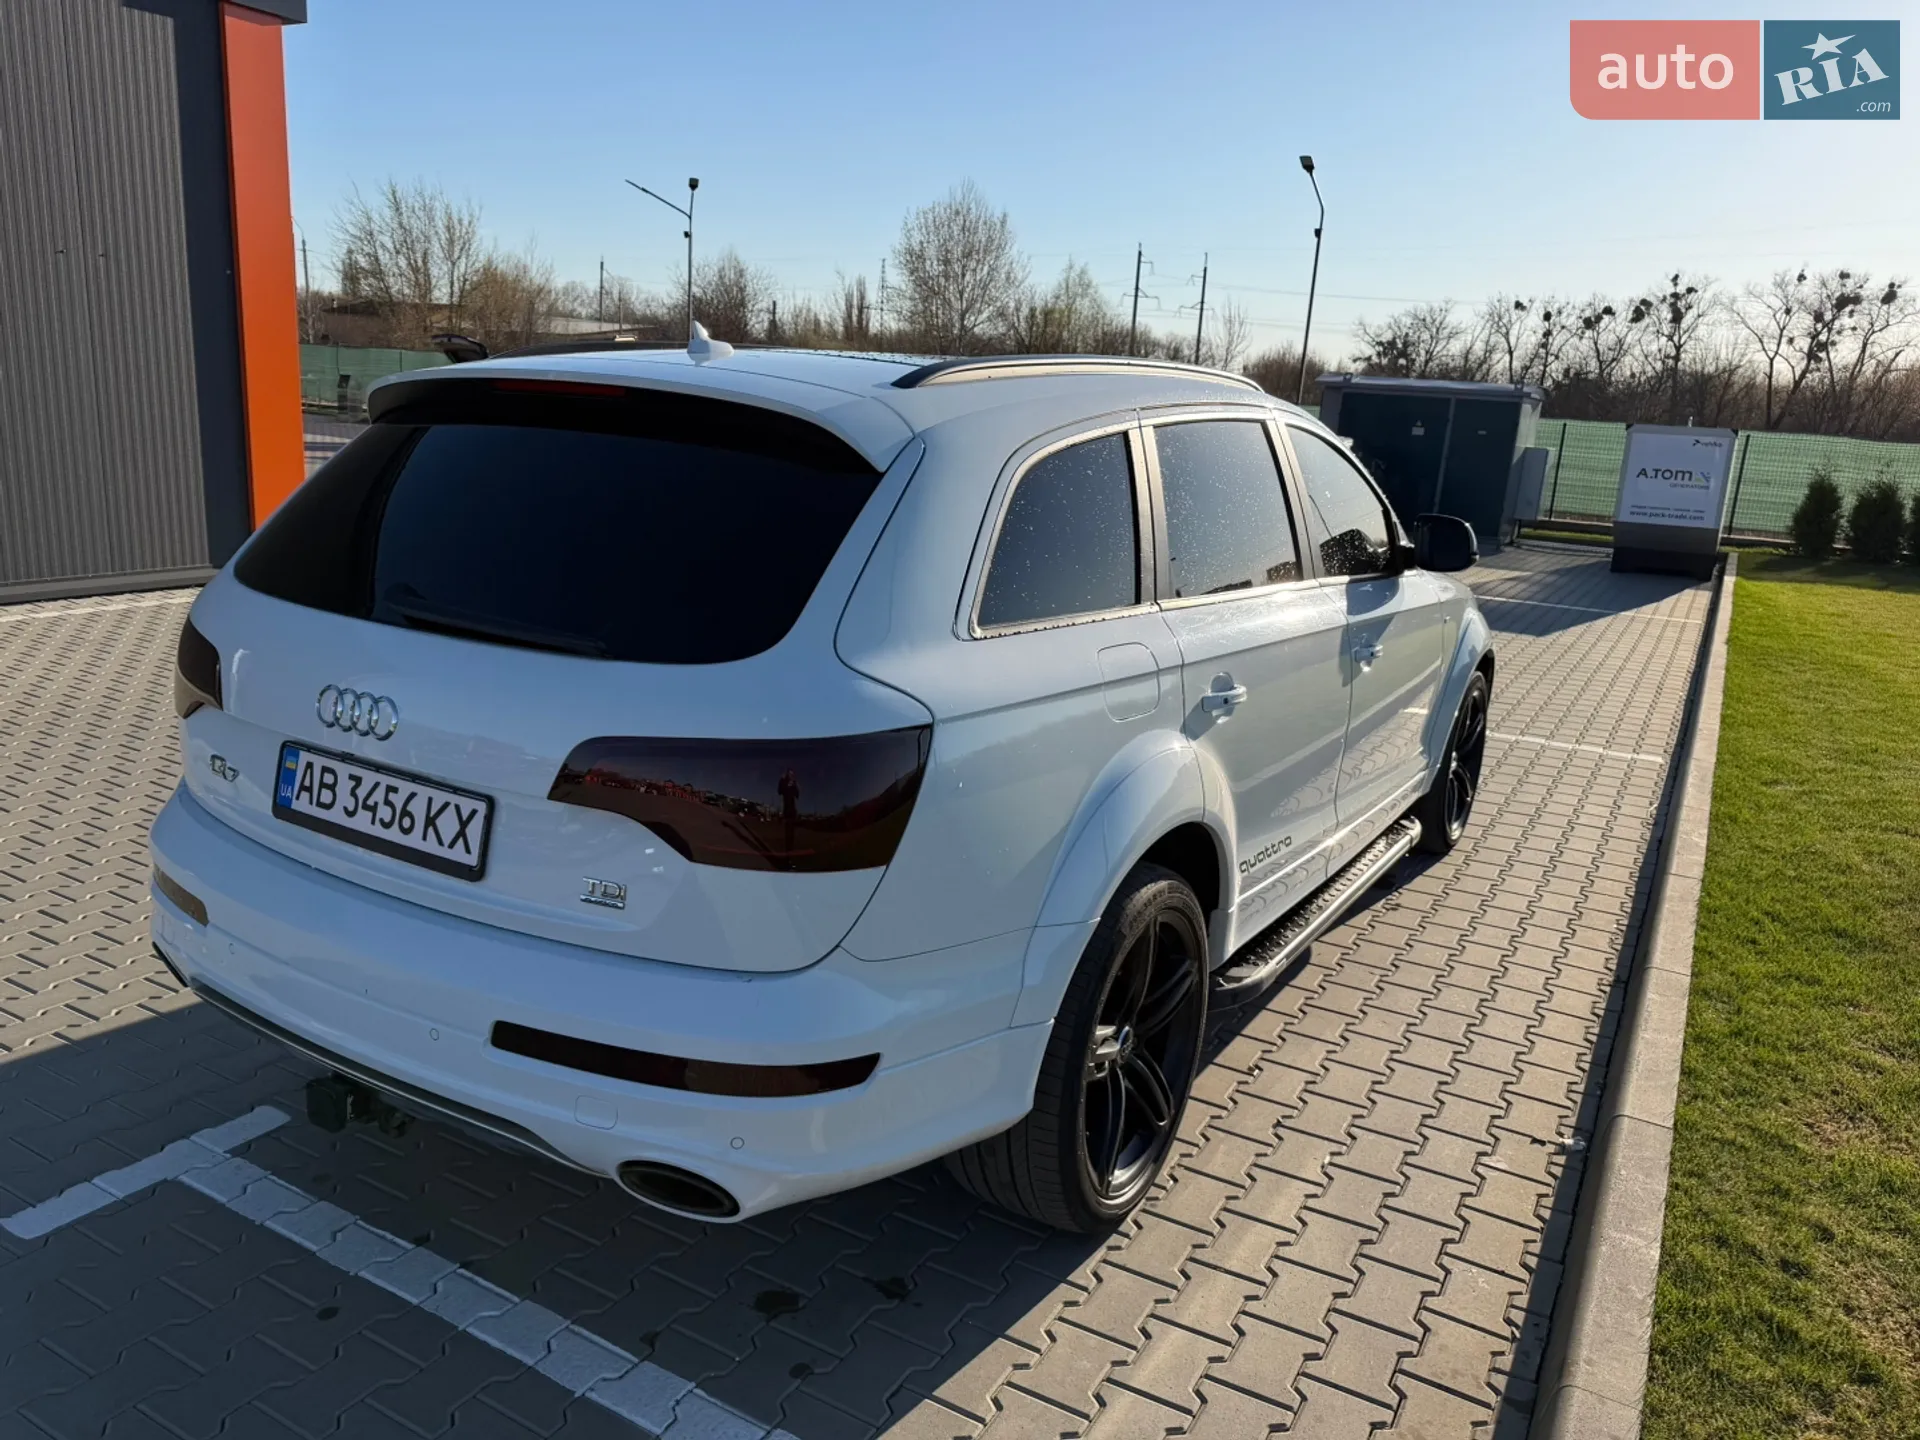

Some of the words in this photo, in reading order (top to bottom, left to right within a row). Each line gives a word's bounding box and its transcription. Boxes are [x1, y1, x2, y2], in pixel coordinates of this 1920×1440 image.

[210, 754, 240, 783] Q7
[280, 786, 292, 799] UA
[295, 761, 338, 811] AB
[343, 773, 418, 836] 3456
[422, 795, 479, 855] KX
[1239, 836, 1292, 874] quattro
[582, 876, 627, 901] TDI
